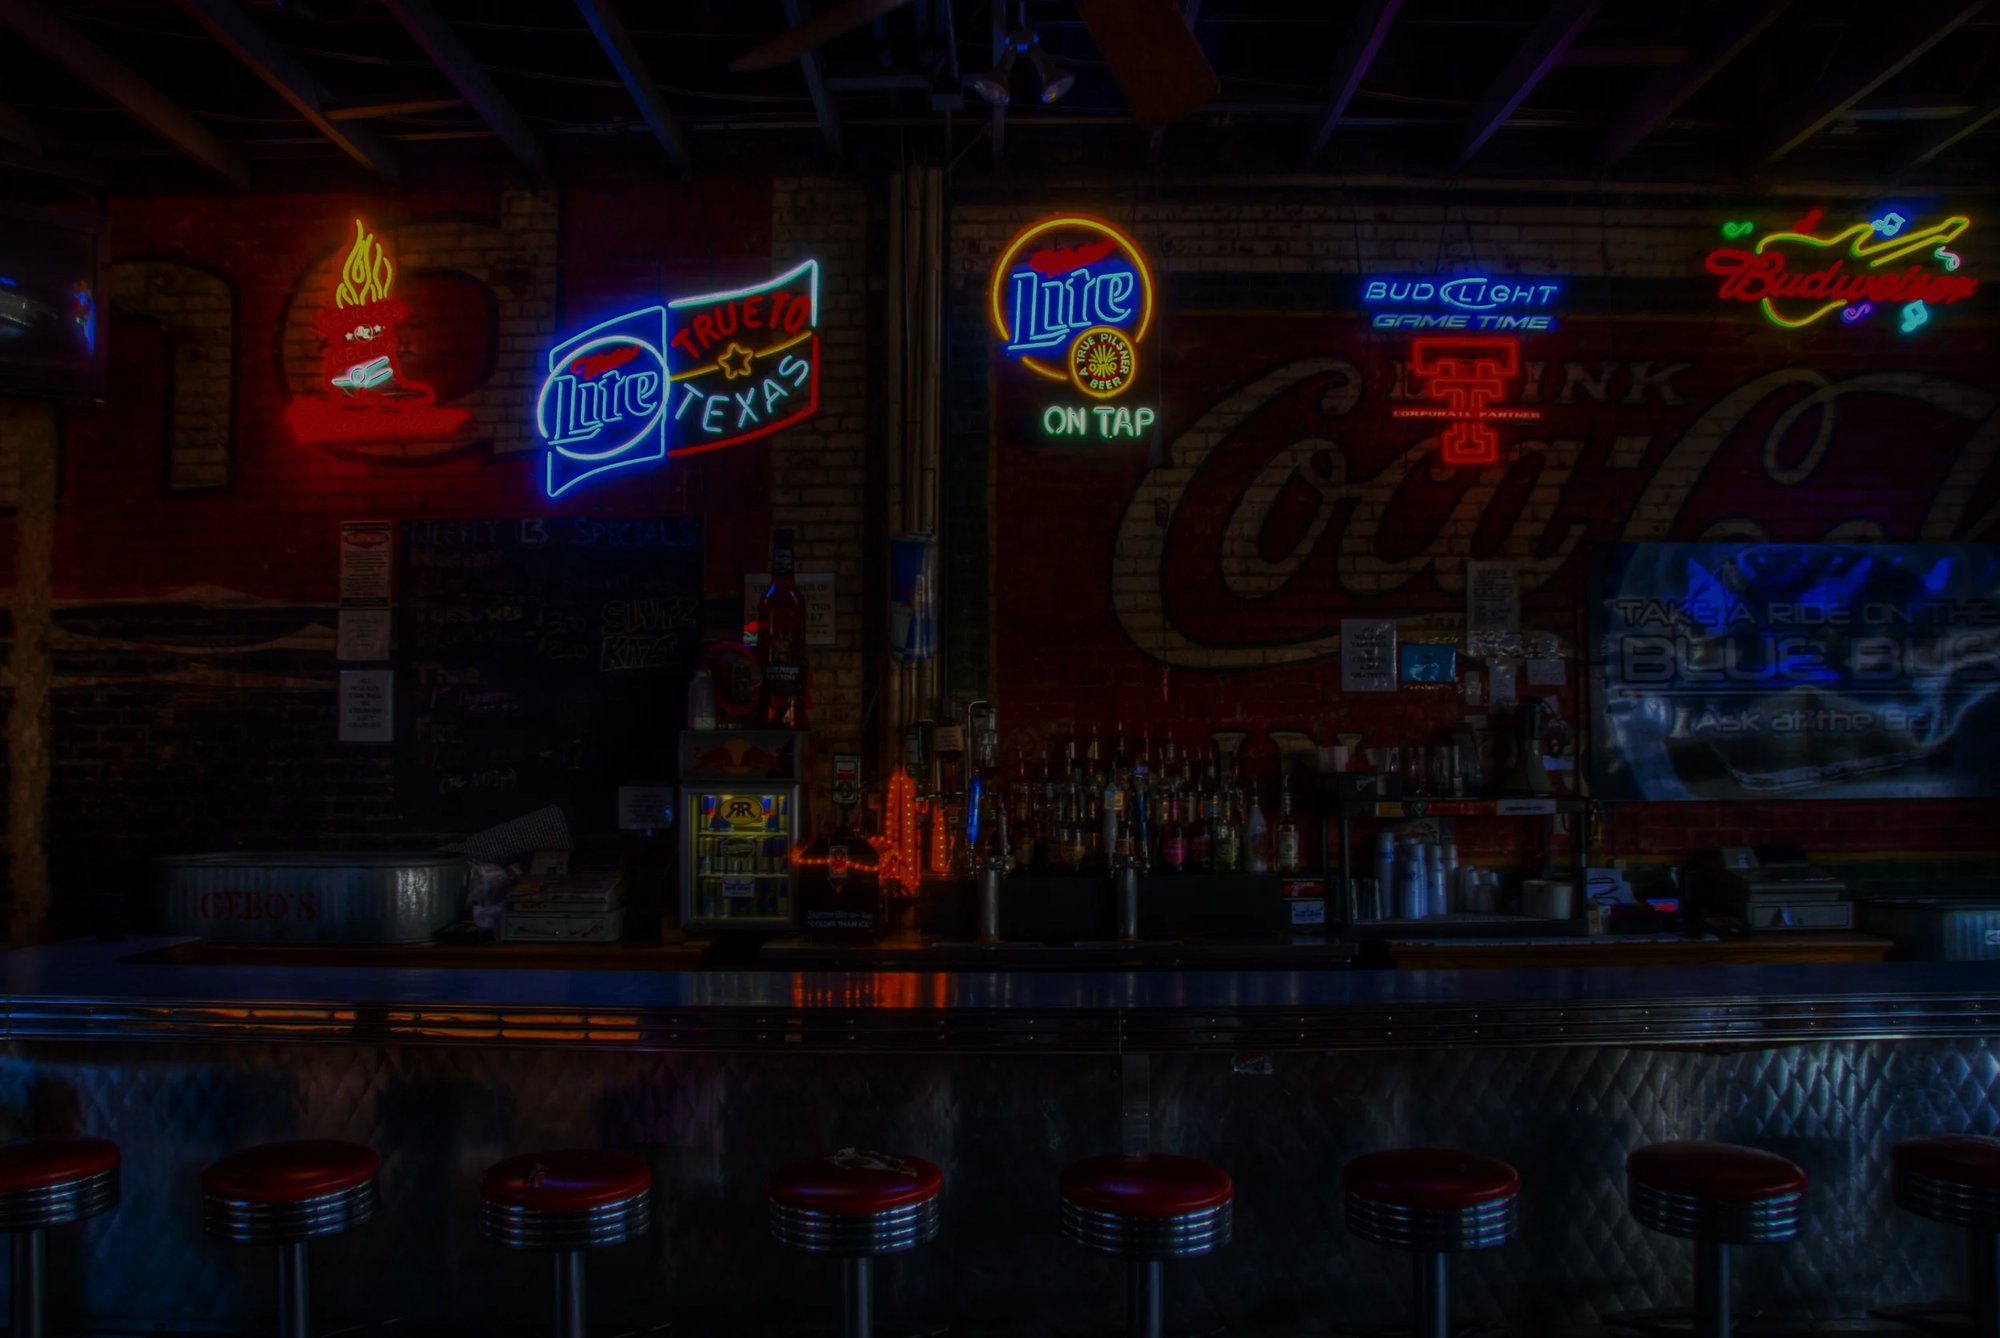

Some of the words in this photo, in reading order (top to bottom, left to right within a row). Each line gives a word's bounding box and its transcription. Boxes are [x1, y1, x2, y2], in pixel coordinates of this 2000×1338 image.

[1704, 248, 1980, 304] Budweiser
[1365, 281, 1434, 300] BUD
[1457, 284, 1558, 303] LIGHT
[319, 303, 402, 329] RECKLESS
[671, 298, 763, 358] TRUE
[770, 291, 811, 334] TO
[1007, 268, 1134, 350] Lite
[1373, 314, 1471, 329] GAME
[1476, 315, 1552, 330] TIME
[331, 340, 393, 366] KELLY
[1076, 337, 1096, 364] TRUE
[1100, 333, 1130, 375] PILSNER
[675, 355, 809, 433] TEXAS
[1089, 376, 1121, 390] BEER
[548, 370, 658, 446] Lite
[1044, 405, 1086, 435] ON
[1092, 405, 1155, 439] TAP
[1392, 409, 1472, 419] CORPORATE
[1479, 410, 1541, 419] PARTNER
[569, 516, 697, 547] SPECIALS
[1616, 600, 1719, 625] TAKE
[1727, 602, 1756, 625] A
[1768, 602, 1851, 625] RIDE
[1863, 602, 1913, 625] ON
[1923, 601, 2000, 625] THE
[1622, 634, 1838, 683] BLUE
[1846, 634, 2000, 683] BUS
[1695, 711, 1761, 731] Ask
[1771, 710, 1807, 731] at
[1816, 709, 1874, 731] the
[200, 891, 317, 922] GEBO'S
